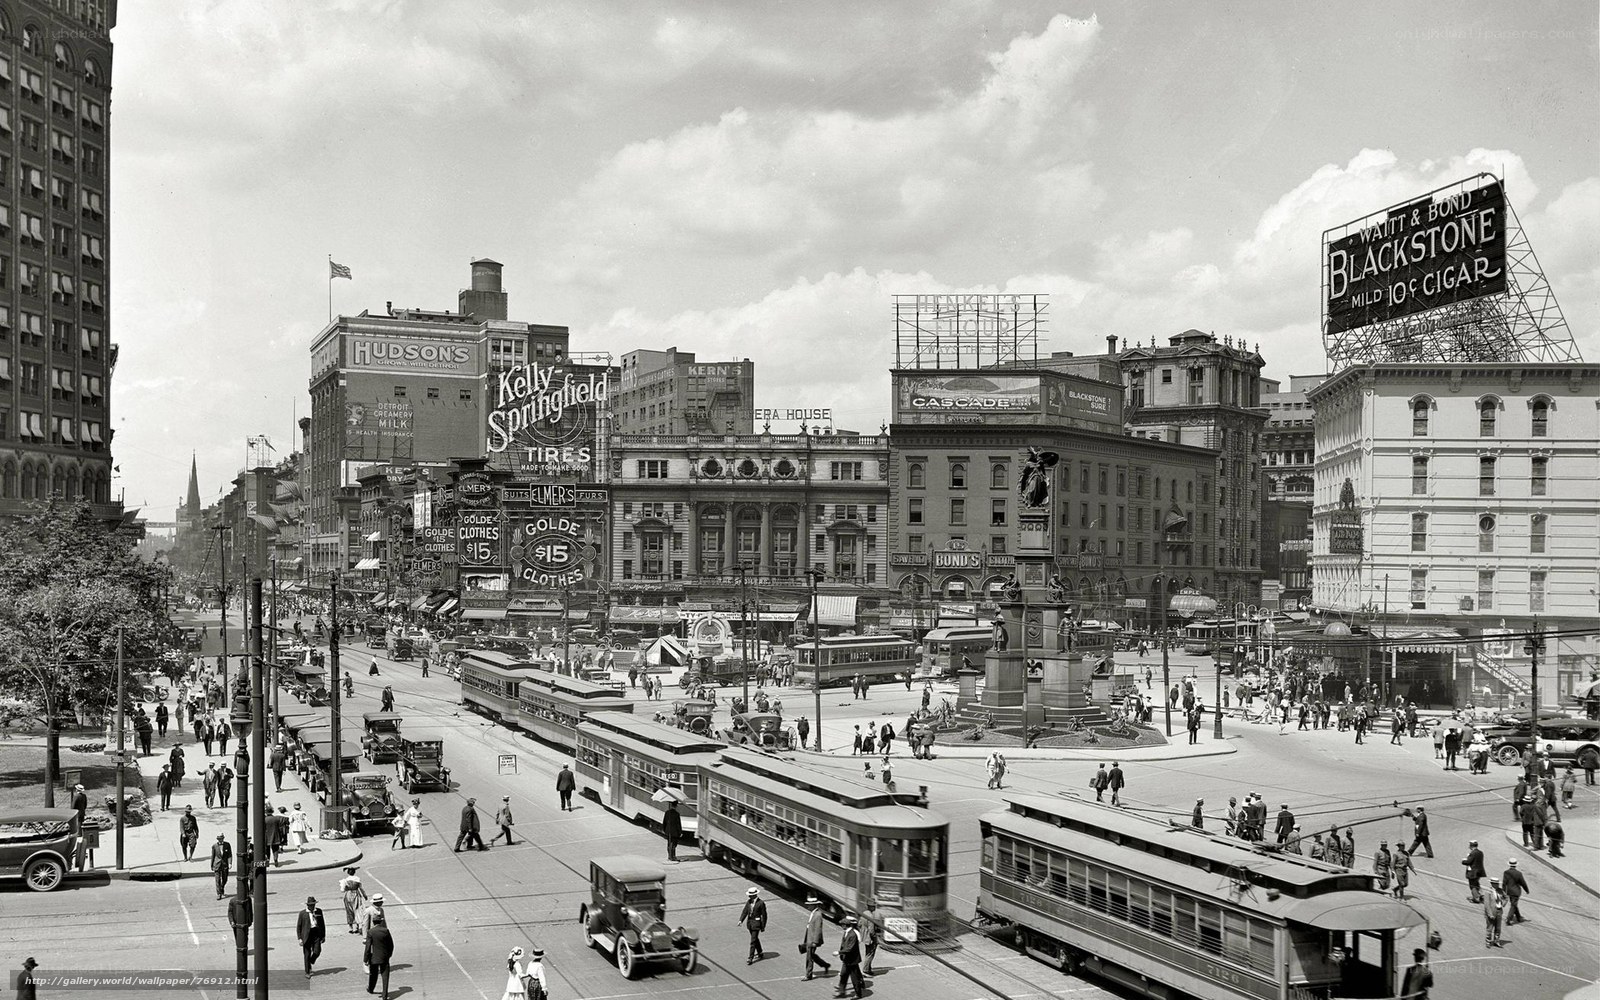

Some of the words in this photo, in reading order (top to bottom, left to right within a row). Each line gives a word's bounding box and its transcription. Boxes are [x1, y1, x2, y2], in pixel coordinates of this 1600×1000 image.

[1359, 213, 1407, 244] WAITT
[1409, 207, 1421, 227] &
[1428, 190, 1472, 222] BOND
[1329, 207, 1496, 300] BLACKSTONE
[1351, 288, 1382, 309] MILD
[1422, 256, 1502, 296] CIGAR
[936, 318, 1010, 337] FLOUR
[353, 340, 471, 365] HUDSON'S
[428, 362, 460, 370] DETROIT
[688, 366, 742, 376] KERN'S
[912, 398, 1010, 407] CASCADE
[1068, 390, 1107, 404] BLACKSTONE
[378, 403, 409, 411] DETROIT
[486, 372, 608, 453] Springfield
[1090, 402, 1107, 411] SURE
[373, 410, 414, 419] CREAMERY
[786, 408, 831, 420] HOUSE
[379, 420, 408, 429] MILK
[525, 447, 591, 464] TIRES
[459, 484, 491, 493] ELMER'S
[504, 491, 529, 499] SUITS
[531, 485, 574, 506] ELMER'S
[579, 492, 603, 500] FURS
[464, 515, 493, 524] GOLDE
[525, 517, 581, 536] GOLDE
[425, 528, 455, 538] GOLDE
[459, 527, 499, 540] CLOTHES
[425, 543, 455, 552] CLOTHES
[466, 542, 491, 560] $15
[535, 545, 568, 563] $15
[935, 552, 979, 567] BOND'S
[523, 568, 584, 588] CLOTHES
